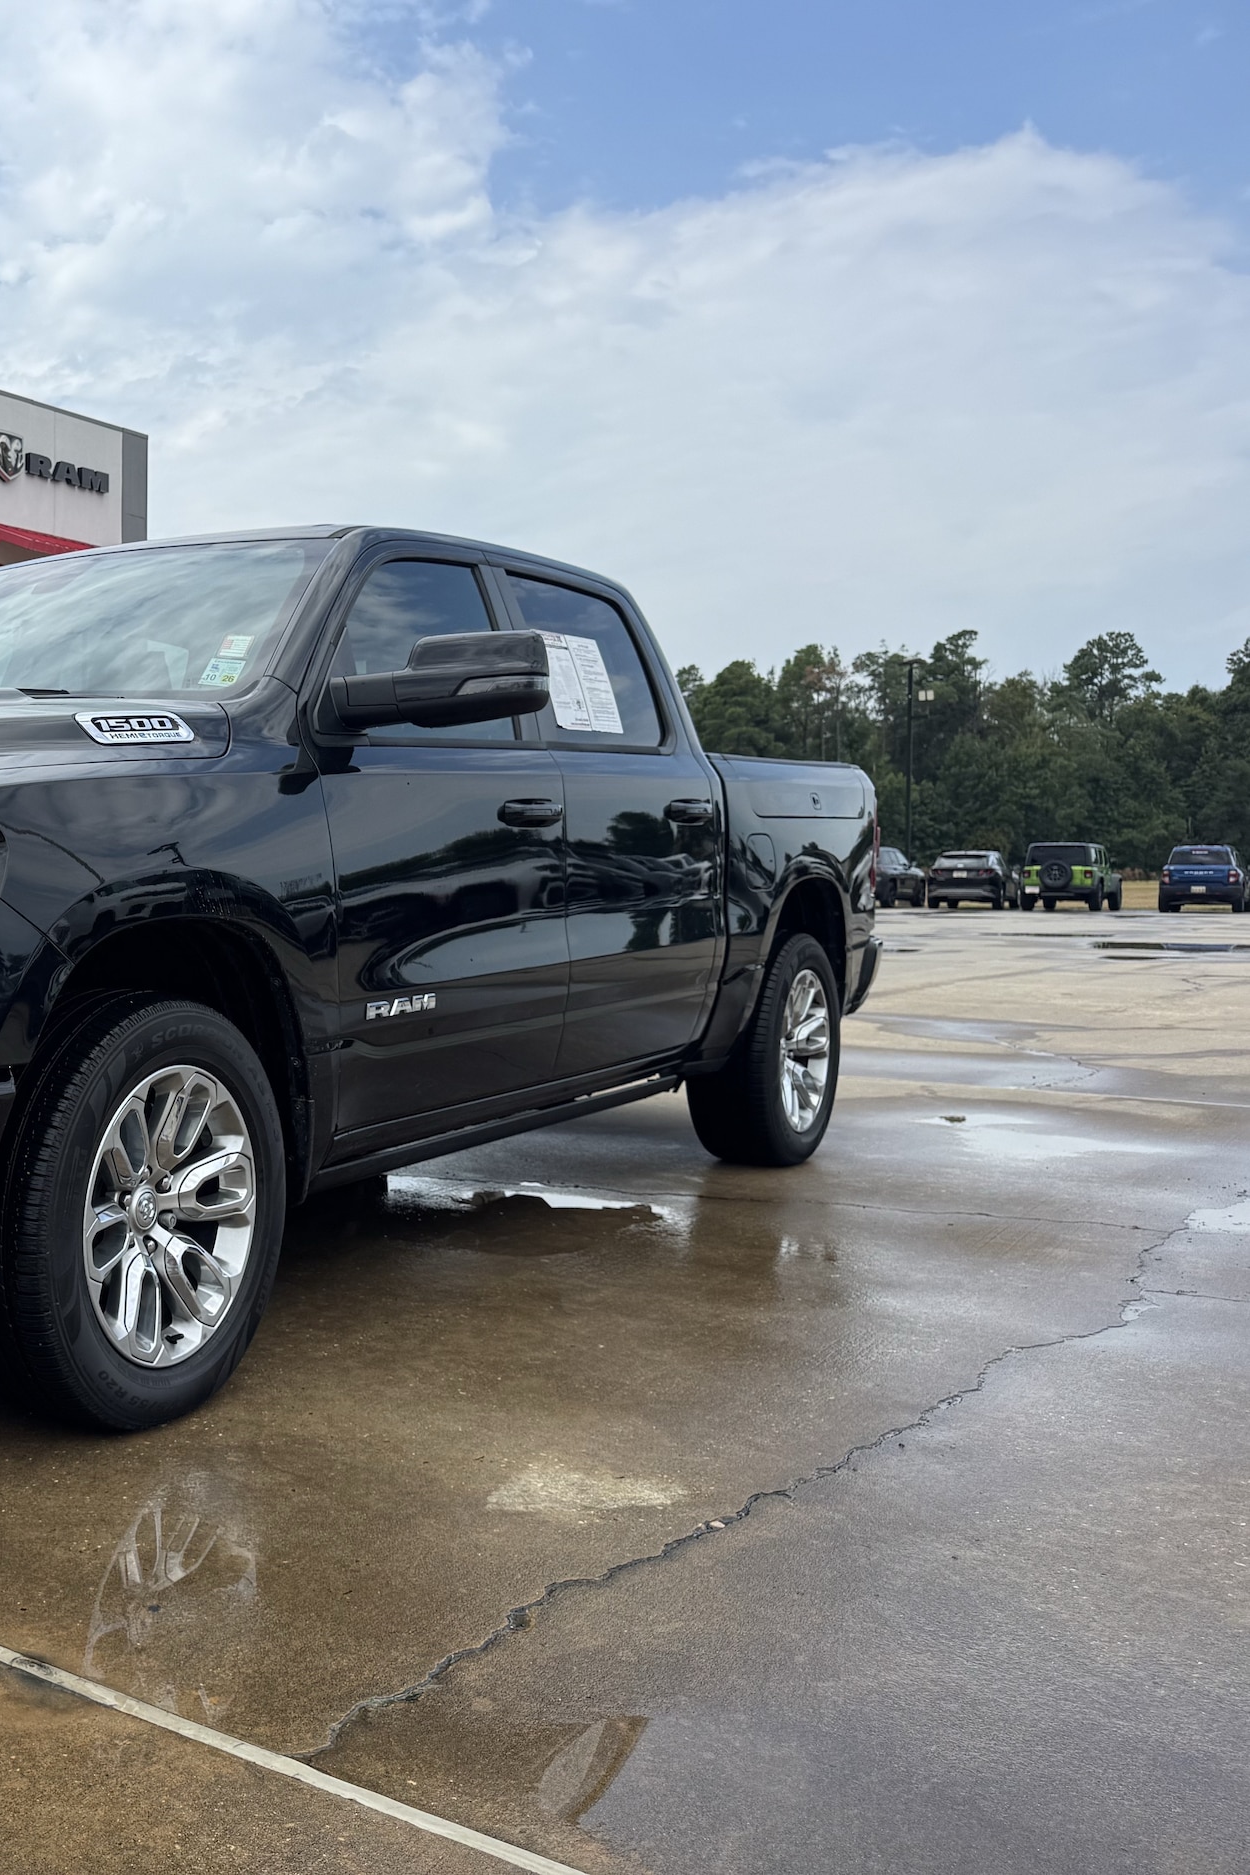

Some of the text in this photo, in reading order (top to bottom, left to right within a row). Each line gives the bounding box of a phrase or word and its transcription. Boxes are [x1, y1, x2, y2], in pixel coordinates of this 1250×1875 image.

[25, 452, 109, 493] RAM
[94, 717, 173, 731] 1500
[110, 732, 139, 740] HEMI
[365, 992, 436, 1020] RAM
